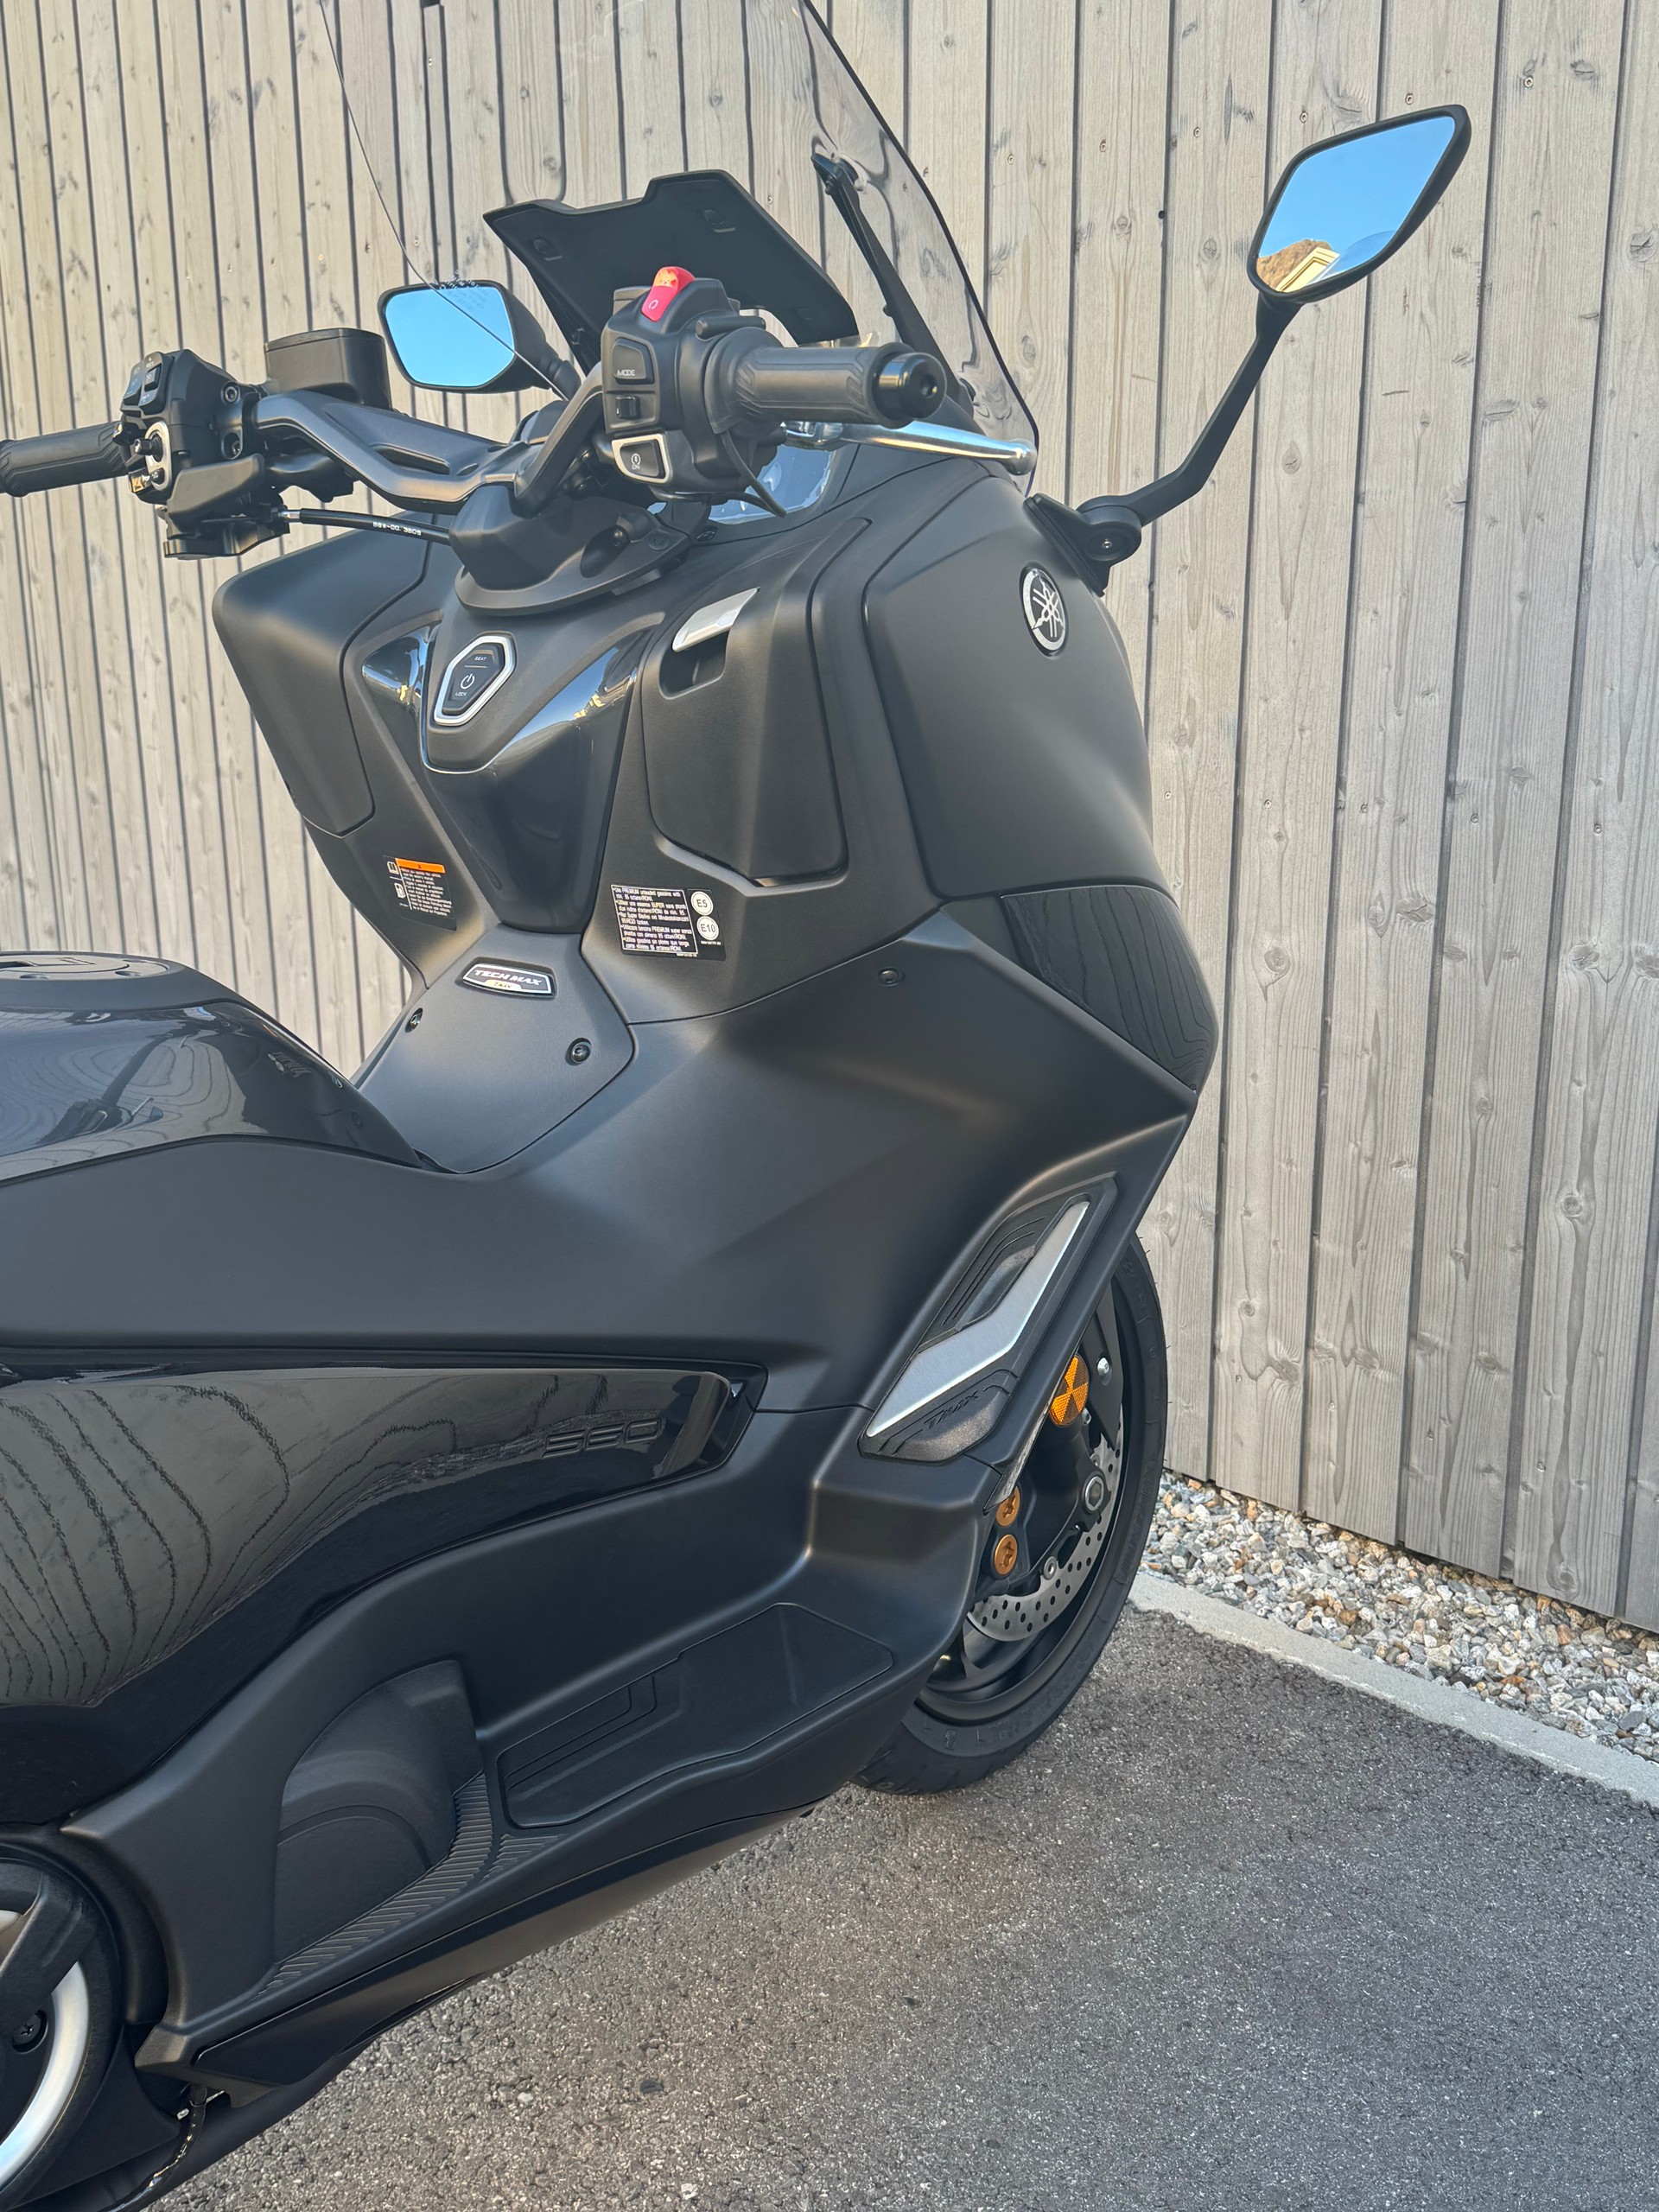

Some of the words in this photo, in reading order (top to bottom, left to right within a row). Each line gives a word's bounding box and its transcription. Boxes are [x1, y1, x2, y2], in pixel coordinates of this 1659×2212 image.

[696, 899, 708, 908] E5
[700, 924, 716, 933] E10
[474, 969, 510, 980] TECH
[509, 975, 542, 985] MAX
[542, 1417, 665, 1458] 560
